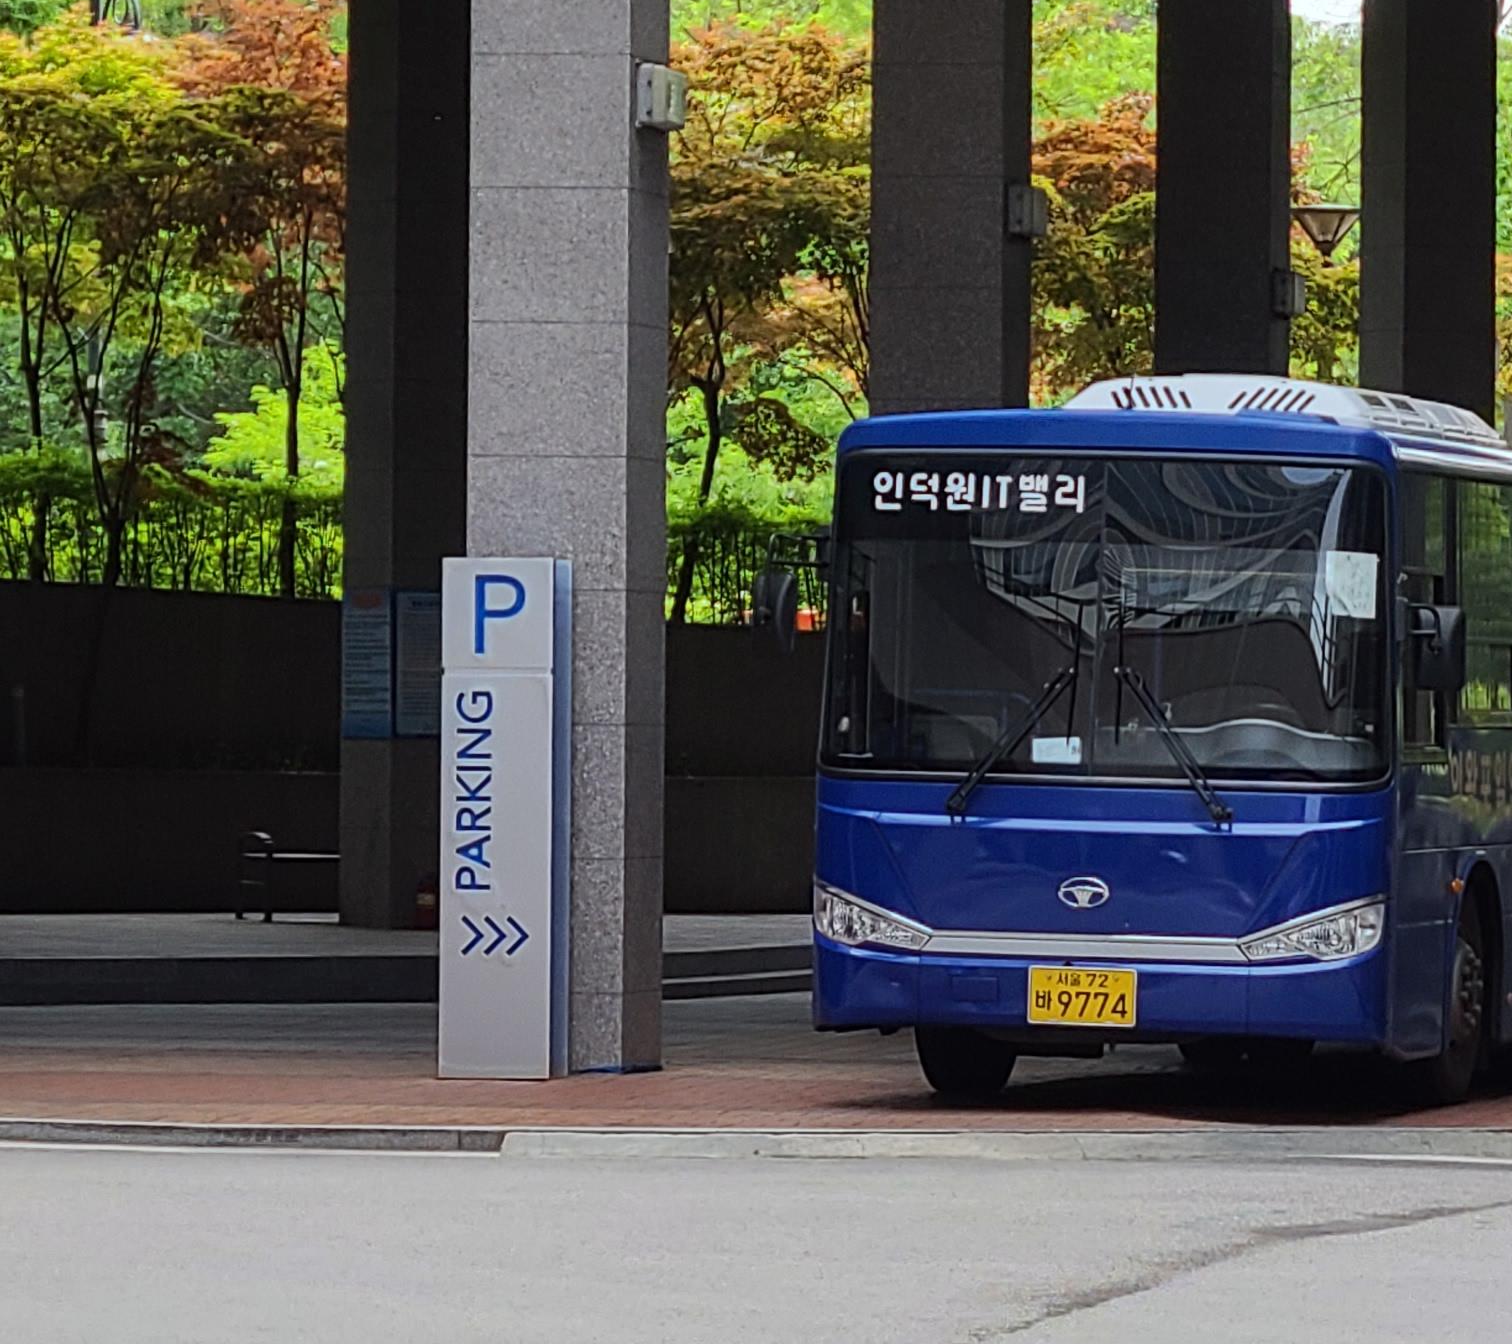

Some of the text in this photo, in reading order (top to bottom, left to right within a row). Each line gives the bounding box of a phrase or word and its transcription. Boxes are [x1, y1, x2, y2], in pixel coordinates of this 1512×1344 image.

[872, 469, 1087, 514] 인덕원IT밸리
[474, 573, 527, 655] P
[455, 689, 493, 891] PARKING
[1056, 971, 1109, 988] 서울 72
